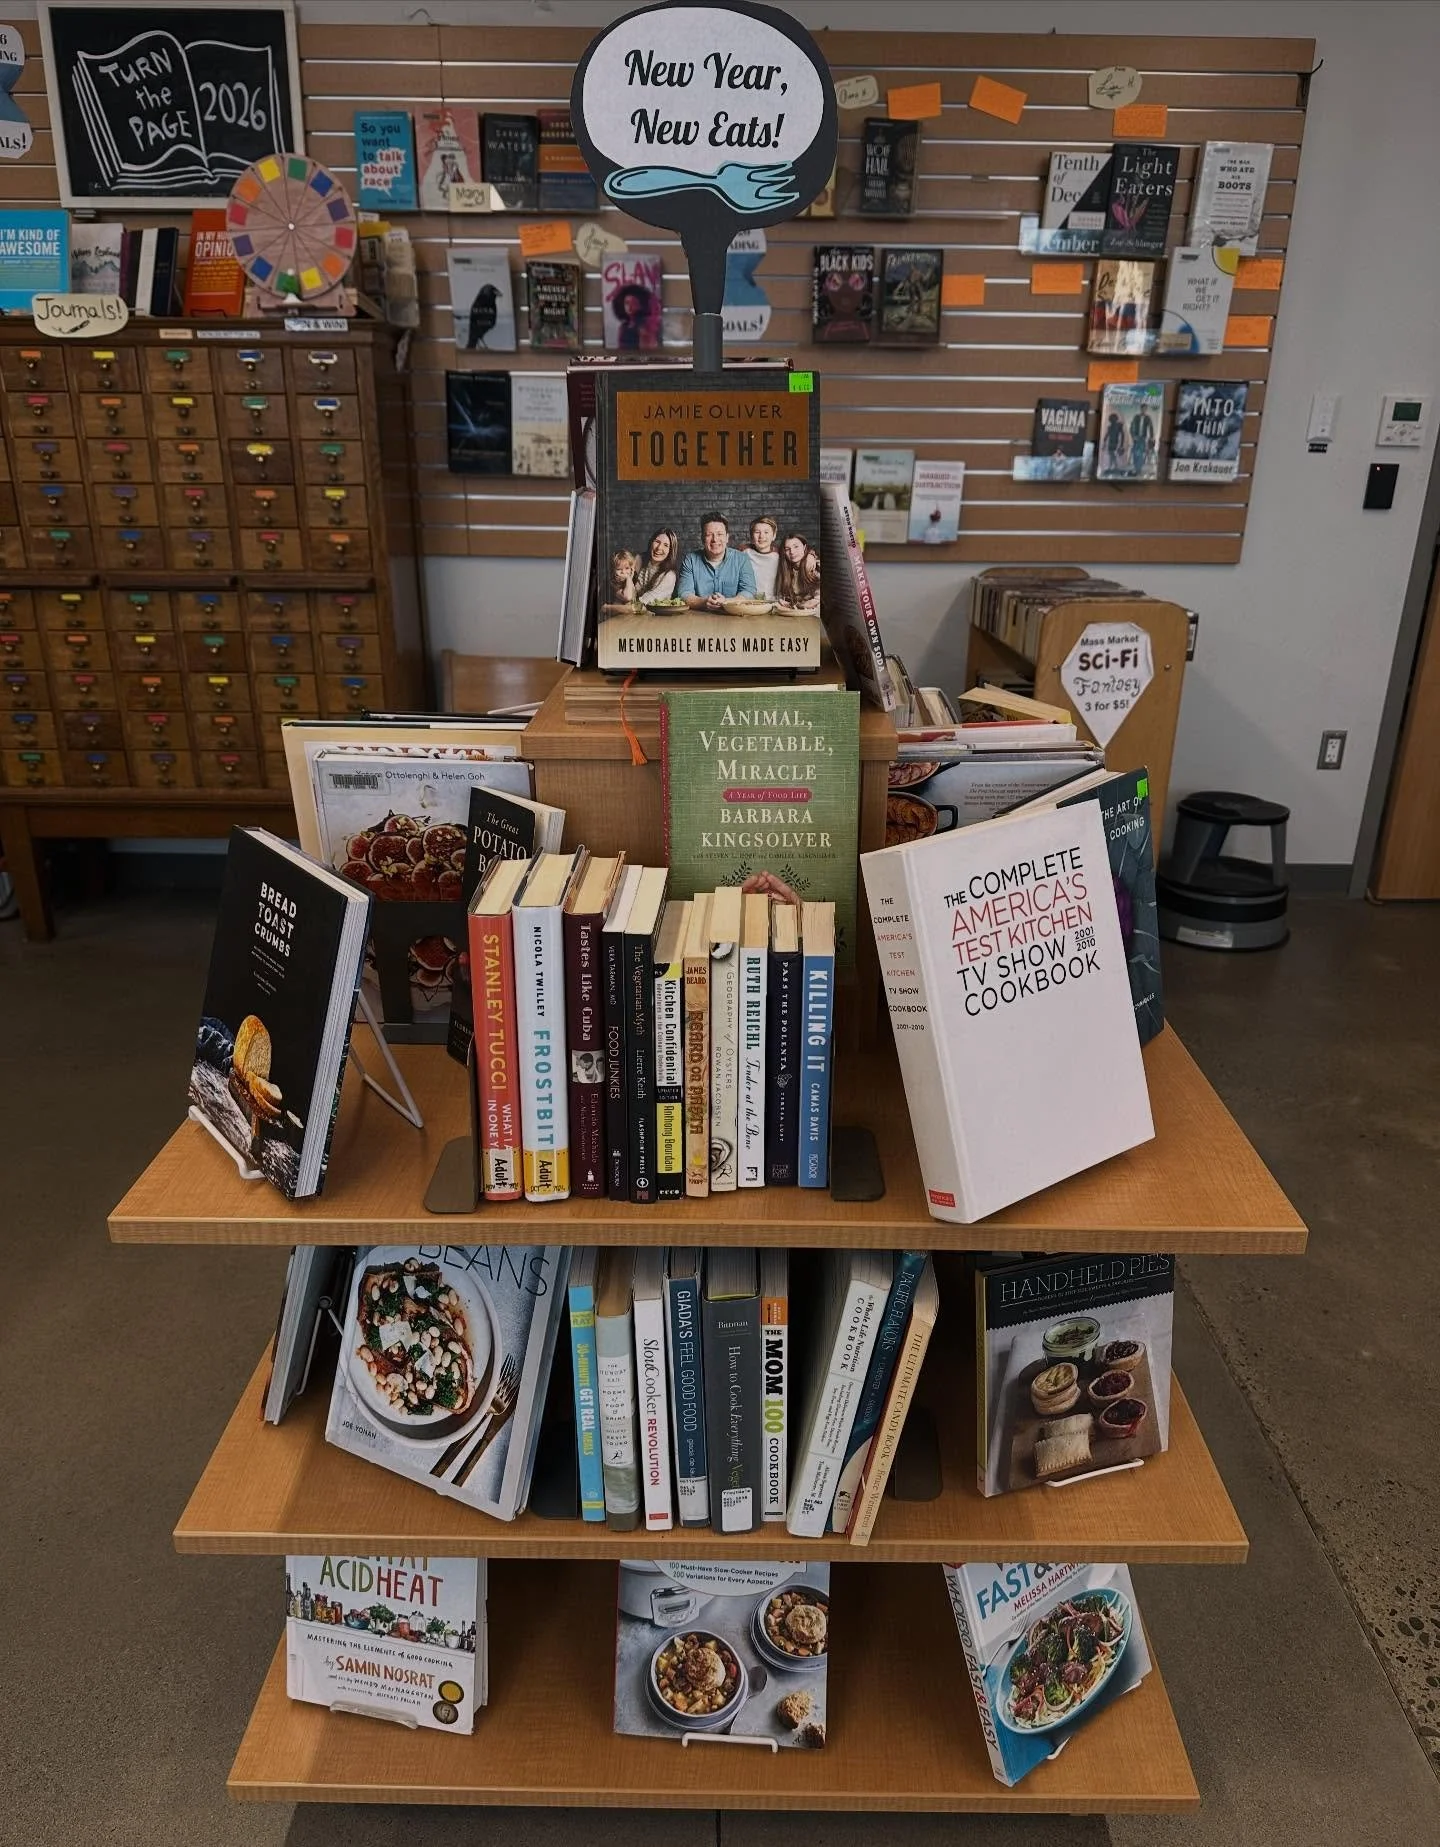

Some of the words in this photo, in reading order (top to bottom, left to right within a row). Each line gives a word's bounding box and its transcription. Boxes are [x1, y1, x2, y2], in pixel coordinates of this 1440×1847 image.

[100, 49, 173, 88] TURN
[624, 49, 695, 87] New
[703, 52, 788, 96] Year,
[136, 86, 172, 111] the
[199, 82, 267, 131] 2026
[129, 111, 193, 151] PAGE
[361, 123, 376, 134] So
[381, 124, 400, 136] you
[630, 108, 700, 145] New
[708, 110, 785, 148] Eats!
[361, 137, 391, 148] want
[363, 151, 376, 161] to
[379, 150, 403, 162] talk
[363, 164, 399, 176] about
[1053, 154, 1100, 172] Tenth
[1122, 156, 1173, 177] Light
[364, 177, 390, 186] race
[1053, 171, 1067, 185] of
[1115, 178, 1173, 196] Eaters
[1218, 181, 1252, 191] BOOTS
[0, 229, 15, 240] I'M
[19, 229, 42, 241] KIND
[46, 229, 60, 240] OF
[0, 241, 61, 256] AWESOME
[820, 254, 848, 271] BLACK
[851, 254, 873, 271] KIDS
[604, 260, 660, 301] SLAY
[36, 297, 123, 320] Journals!
[643, 404, 703, 419] JAMIE
[709, 404, 783, 419] OLIVER
[1041, 408, 1085, 427] VAGINA
[1193, 399, 1235, 417] INTO
[1195, 420, 1226, 435] THIN
[628, 430, 798, 467] TOGETHER
[1174, 461, 1190, 472] Jon
[1192, 461, 1233, 474] Krakauer
[853, 555, 865, 587] MAKE
[860, 588, 873, 620] YOUR
[618, 637, 692, 653] MEMORABLE
[697, 637, 737, 653] MEALS
[742, 637, 774, 653] MADE
[780, 637, 810, 653] EASY
[866, 618, 880, 645] OWN
[1080, 638, 1104, 646] Mass
[1107, 635, 1139, 645] Market
[873, 644, 886, 674] SODA
[1073, 675, 1140, 698] Fantasy
[1085, 702, 1092, 712] 3
[1094, 701, 1109, 711] for
[1112, 699, 1129, 710] $5!
[385, 771, 430, 781] Ottolenghi
[441, 772, 466, 780] Helen
[467, 772, 485, 780] Goh
[720, 808, 814, 824] BARBARA
[1109, 816, 1145, 840] COOKING
[473, 825, 527, 861] POTATO
[701, 832, 832, 848] KINGSOLVER
[944, 890, 966, 909] THE
[968, 846, 1084, 899] COMPLETE
[260, 881, 297, 918] BREAD
[880, 897, 894, 905] THE
[952, 872, 1088, 941] AMERICA'S
[258, 902, 294, 939] TOAST
[873, 915, 910, 924] COMPLETE
[952, 930, 1003, 965] TEST
[1008, 901, 1093, 949] KITCHEN
[1074, 926, 1095, 941] 2001
[254, 922, 291, 957] CRUMBS
[534, 926, 543, 967] NICOLA
[580, 922, 591, 968] Tastes
[876, 933, 913, 942] AMERICA'S
[1076, 937, 1096, 952] 2010
[633, 944, 643, 960] The
[888, 950, 905, 959] TEST
[957, 962, 987, 991] TV
[997, 935, 1066, 979] SHOW
[482, 934, 504, 1025] STANLEY
[634, 961, 644, 1007] Vegetarian
[686, 966, 707, 975] JAMES
[686, 977, 706, 985] BEARD
[746, 956, 761, 994] RUTH
[886, 969, 915, 978] KITCHEN
[964, 950, 1101, 1017] COOKBOOK
[535, 970, 545, 1018] TWILLEY
[581, 973, 593, 1007] Like
[664, 980, 676, 1019] Kitchen
[888, 987, 897, 995] TV
[898, 987, 919, 995] SHOW
[781, 993, 789, 1016] THE
[808, 970, 828, 1046] KILLING
[888, 1004, 928, 1013] COOKBOOK
[583, 1010, 593, 1042] Cuba
[633, 1008, 644, 1036] Myth
[746, 1000, 761, 1050] REICHL
[608, 1025, 620, 1049] FOOD
[488, 1029, 506, 1091] TUCCI
[636, 1049, 644, 1076] Lierre
[664, 1023, 678, 1085] Confidential
[714, 1046, 722, 1079] ROWAN
[807, 1054, 825, 1072] IT
[608, 1051, 621, 1100] JUNKIES
[636, 1077, 646, 1100] Keith
[487, 1099, 497, 1112] IN
[810, 1082, 820, 1116] CAMAS
[488, 1115, 498, 1137] ONE
[661, 1105, 675, 1137] Anthony
[809, 1117, 820, 1142] DAVIS
[663, 1138, 676, 1172] Bourdain
[494, 1158, 509, 1187] Adult
[539, 1159, 553, 1188] Adult
[893, 1271, 914, 1309] PACIFIC
[1001, 1260, 1125, 1302] HANDHELD
[1129, 1253, 1170, 1276] PIES
[677, 1290, 693, 1340] GIADA'S
[840, 1297, 865, 1370] COOKBOOK
[880, 1308, 903, 1352] FLAVORS
[679, 1341, 693, 1368] FEEL
[764, 1338, 783, 1395] MOM
[681, 1370, 695, 1400] GOOD
[682, 1402, 697, 1432] FOOD
[764, 1398, 784, 1434] 100
[342, 1421, 354, 1430] JOE
[354, 1425, 377, 1440] YONAN
[647, 1418, 660, 1486] REVOLUTION
[769, 1437, 780, 1504] COOKBOOK
[319, 1556, 374, 1593] ACID
[376, 1566, 444, 1607] HEAT
[669, 1562, 680, 1570] 100
[680, 1564, 713, 1573] Must-Have
[713, 1566, 754, 1576] Slow-Cooker
[754, 1570, 779, 1579] Recipes
[686, 1573, 716, 1582] Variations
[727, 1577, 745, 1586] Every
[746, 1578, 774, 1586] Appetite
[307, 1633, 347, 1649] MASTERING
[349, 1641, 362, 1651] THE
[363, 1643, 396, 1657] ELEMENTS
[406, 1654, 423, 1663] GOOD
[424, 1656, 454, 1669] COOKING
[323, 1656, 336, 1672] by
[336, 1655, 381, 1678] SAMIN
[383, 1665, 436, 1689] NOSRAT
